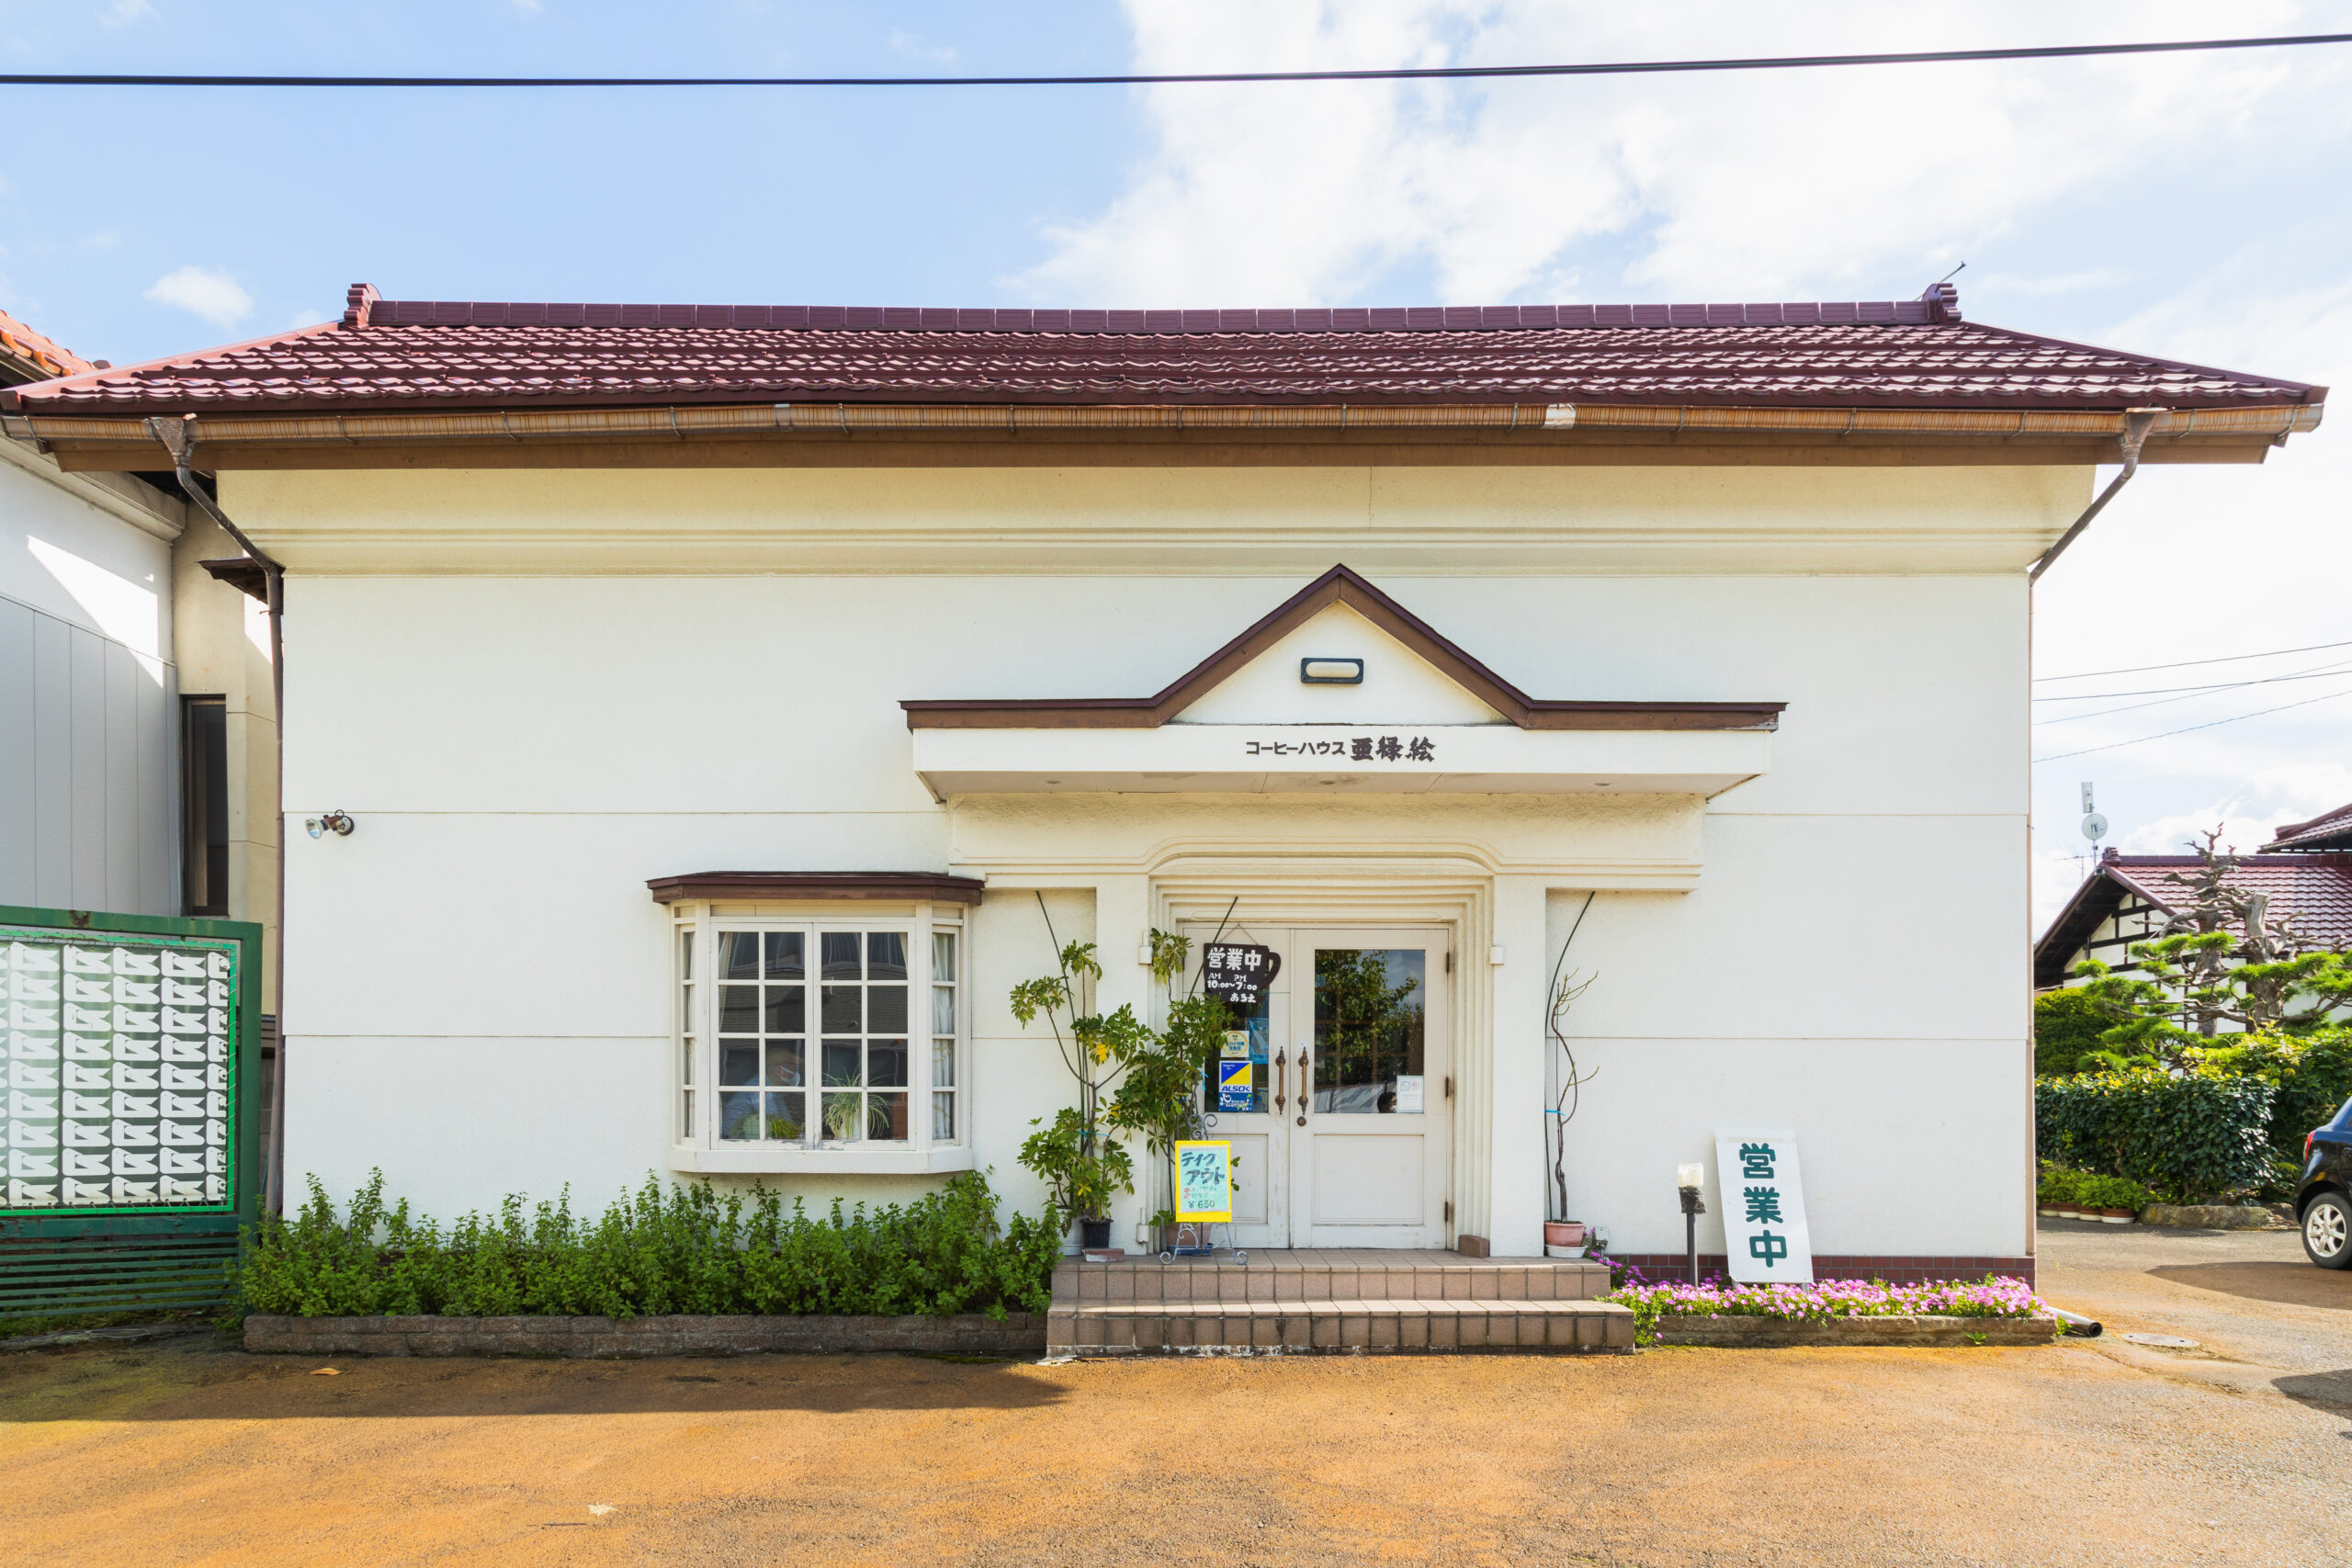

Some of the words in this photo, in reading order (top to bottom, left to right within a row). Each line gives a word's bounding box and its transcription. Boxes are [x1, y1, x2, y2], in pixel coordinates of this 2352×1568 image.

[1246, 740, 1346, 755] コーヒーハウス
[1207, 947, 1262, 971] 営業中
[1181, 1152, 1216, 1168] テイク
[1185, 1167, 1226, 1185] アウト
[1739, 1143, 1787, 1268] 営業中
